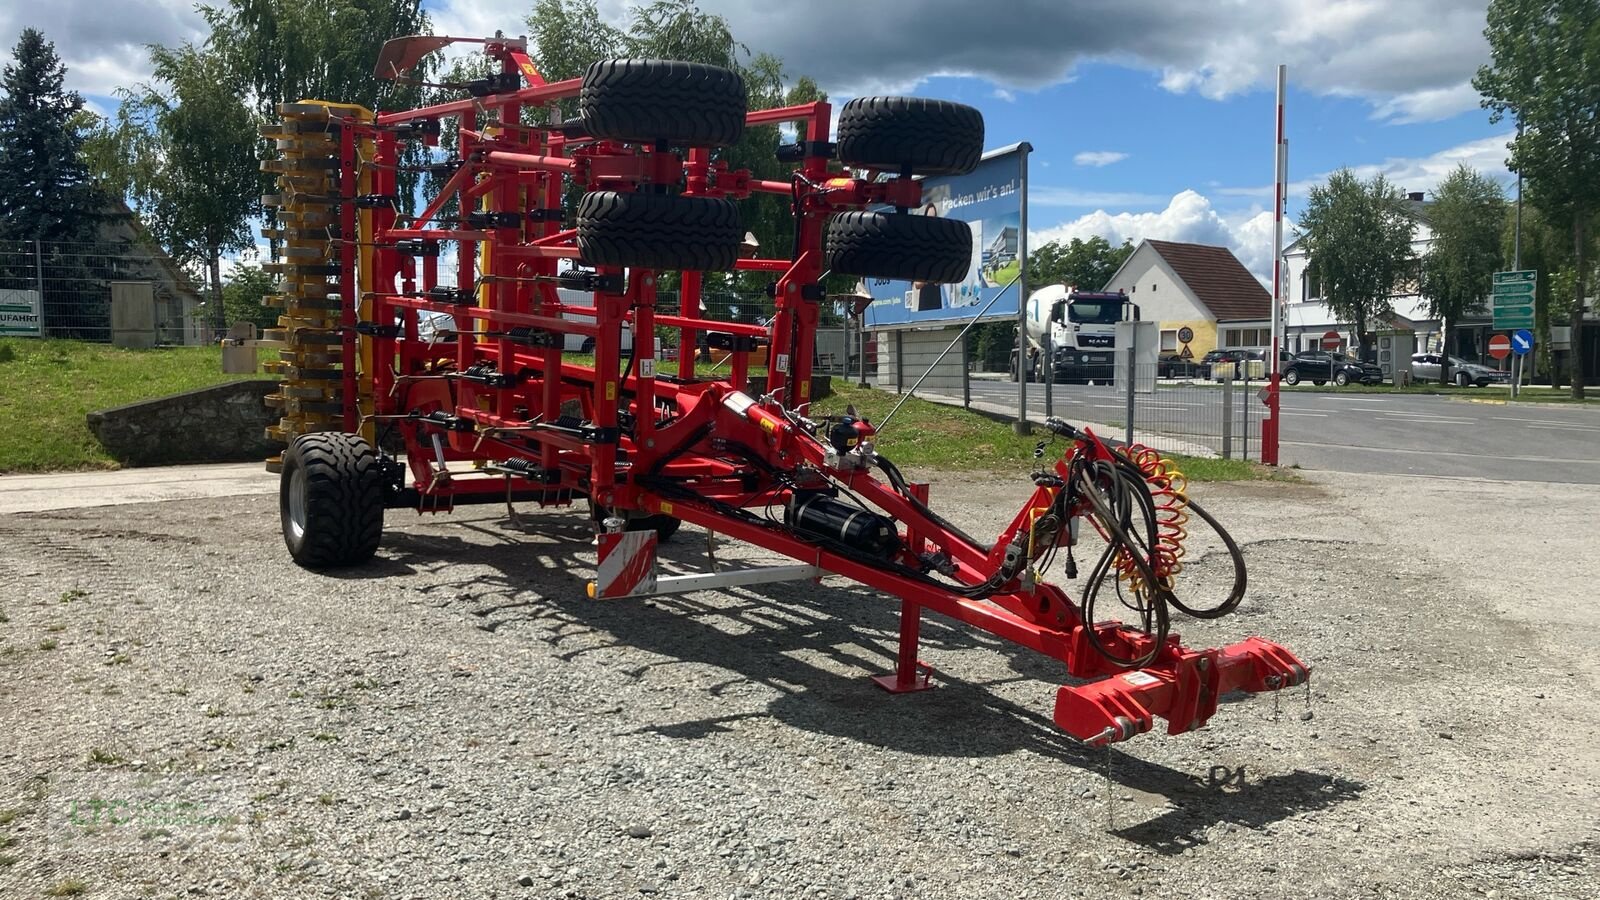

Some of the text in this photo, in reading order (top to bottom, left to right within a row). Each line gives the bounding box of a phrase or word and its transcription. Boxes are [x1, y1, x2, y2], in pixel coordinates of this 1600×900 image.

[942, 178, 1015, 211] Packen wir's an!
[0, 314, 39, 322] UFAHRT
[1180, 330, 1191, 340] 30
